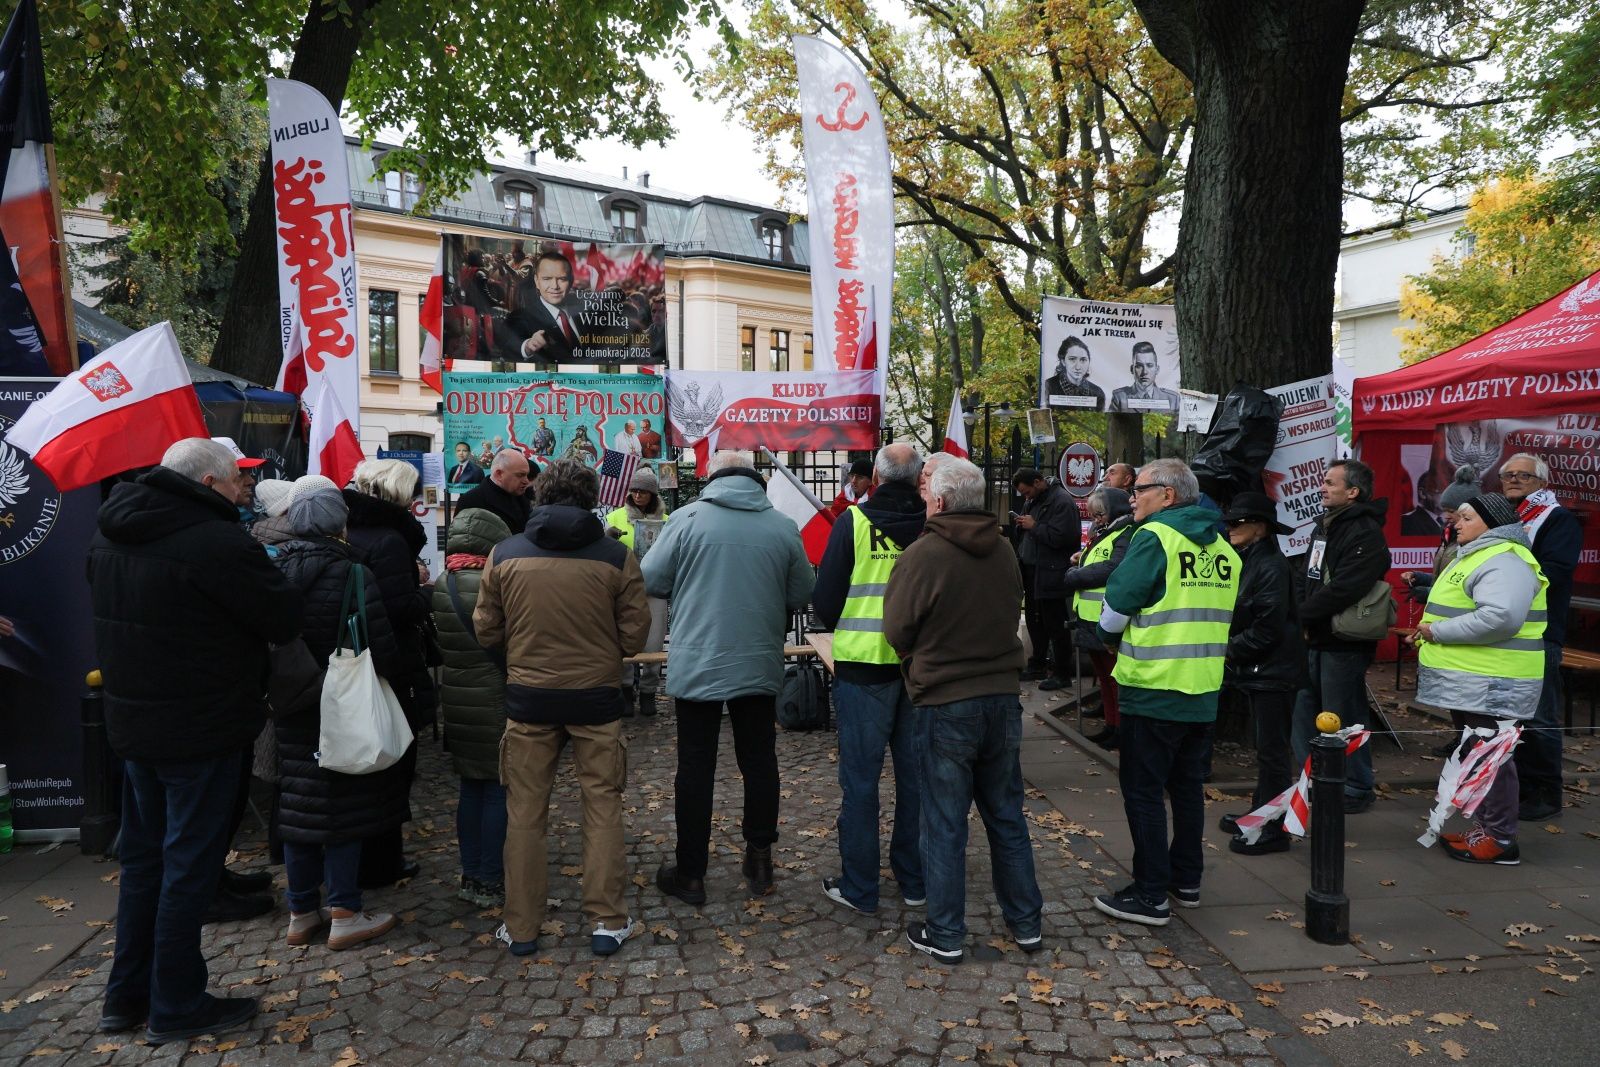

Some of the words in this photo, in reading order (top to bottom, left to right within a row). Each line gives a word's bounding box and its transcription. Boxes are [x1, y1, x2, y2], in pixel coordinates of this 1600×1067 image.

[576, 288, 623, 301] Uczyńmy
[583, 300, 624, 314] Polskę
[1080, 305, 1119, 316] CHWAŁA
[1121, 308, 1142, 318] TYM,
[579, 311, 629, 329] Wielką
[1057, 314, 1093, 325] KTÓRZY
[1095, 317, 1147, 328] ZACHOWALI
[1149, 320, 1164, 330] SIĘ
[580, 334, 590, 344] od
[592, 333, 628, 347] koronacji
[631, 334, 650, 344] 1025
[1082, 328, 1102, 337] JAK
[1104, 329, 1137, 339] TRZEBA
[572, 346, 583, 357] do
[585, 346, 629, 359] demokracji
[631, 347, 650, 357] 2025
[476, 377, 494, 386] moja
[772, 383, 827, 398] KLUBY
[1380, 388, 1436, 412] KLUBY
[1440, 377, 1518, 405] GAZETY
[533, 391, 568, 422] SIĘ
[574, 391, 664, 416] POLSKO
[725, 408, 792, 423] GAZETY
[797, 406, 873, 423] POLSKIEJ
[1506, 431, 1564, 448] GAZETY
[1569, 434, 1600, 449] PO
[1289, 457, 1326, 480] TWOJE
[1284, 498, 1303, 512] MA
